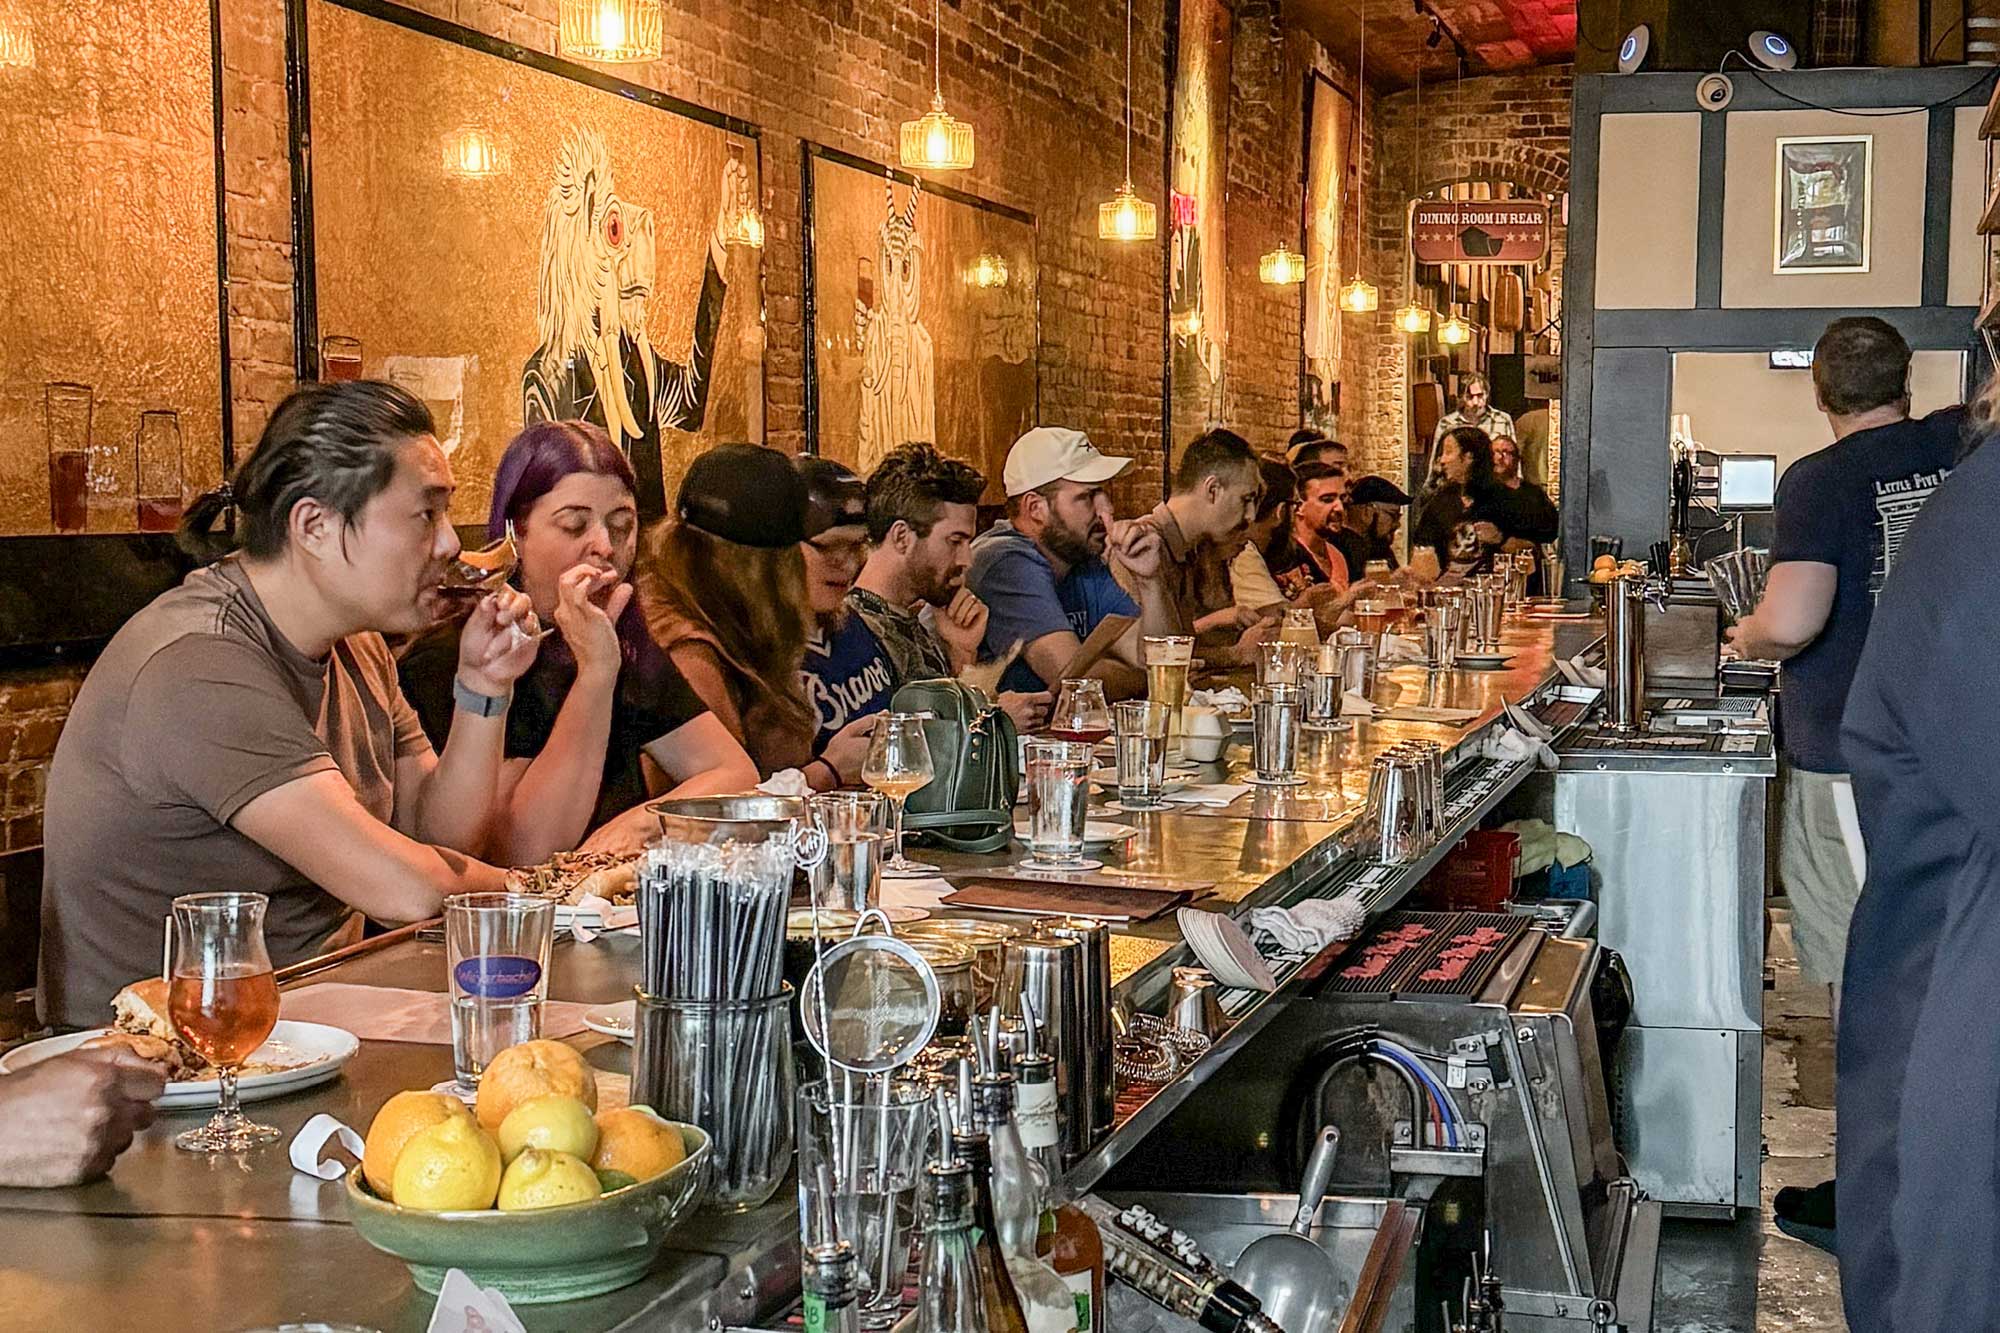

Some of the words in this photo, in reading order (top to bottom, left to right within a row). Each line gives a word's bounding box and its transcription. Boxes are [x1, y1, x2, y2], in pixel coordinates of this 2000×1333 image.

[1419, 213, 1458, 225] DINING
[1461, 213, 1493, 224] ROOM
[1495, 213, 1508, 224] IN
[1510, 213, 1543, 224] REAR
